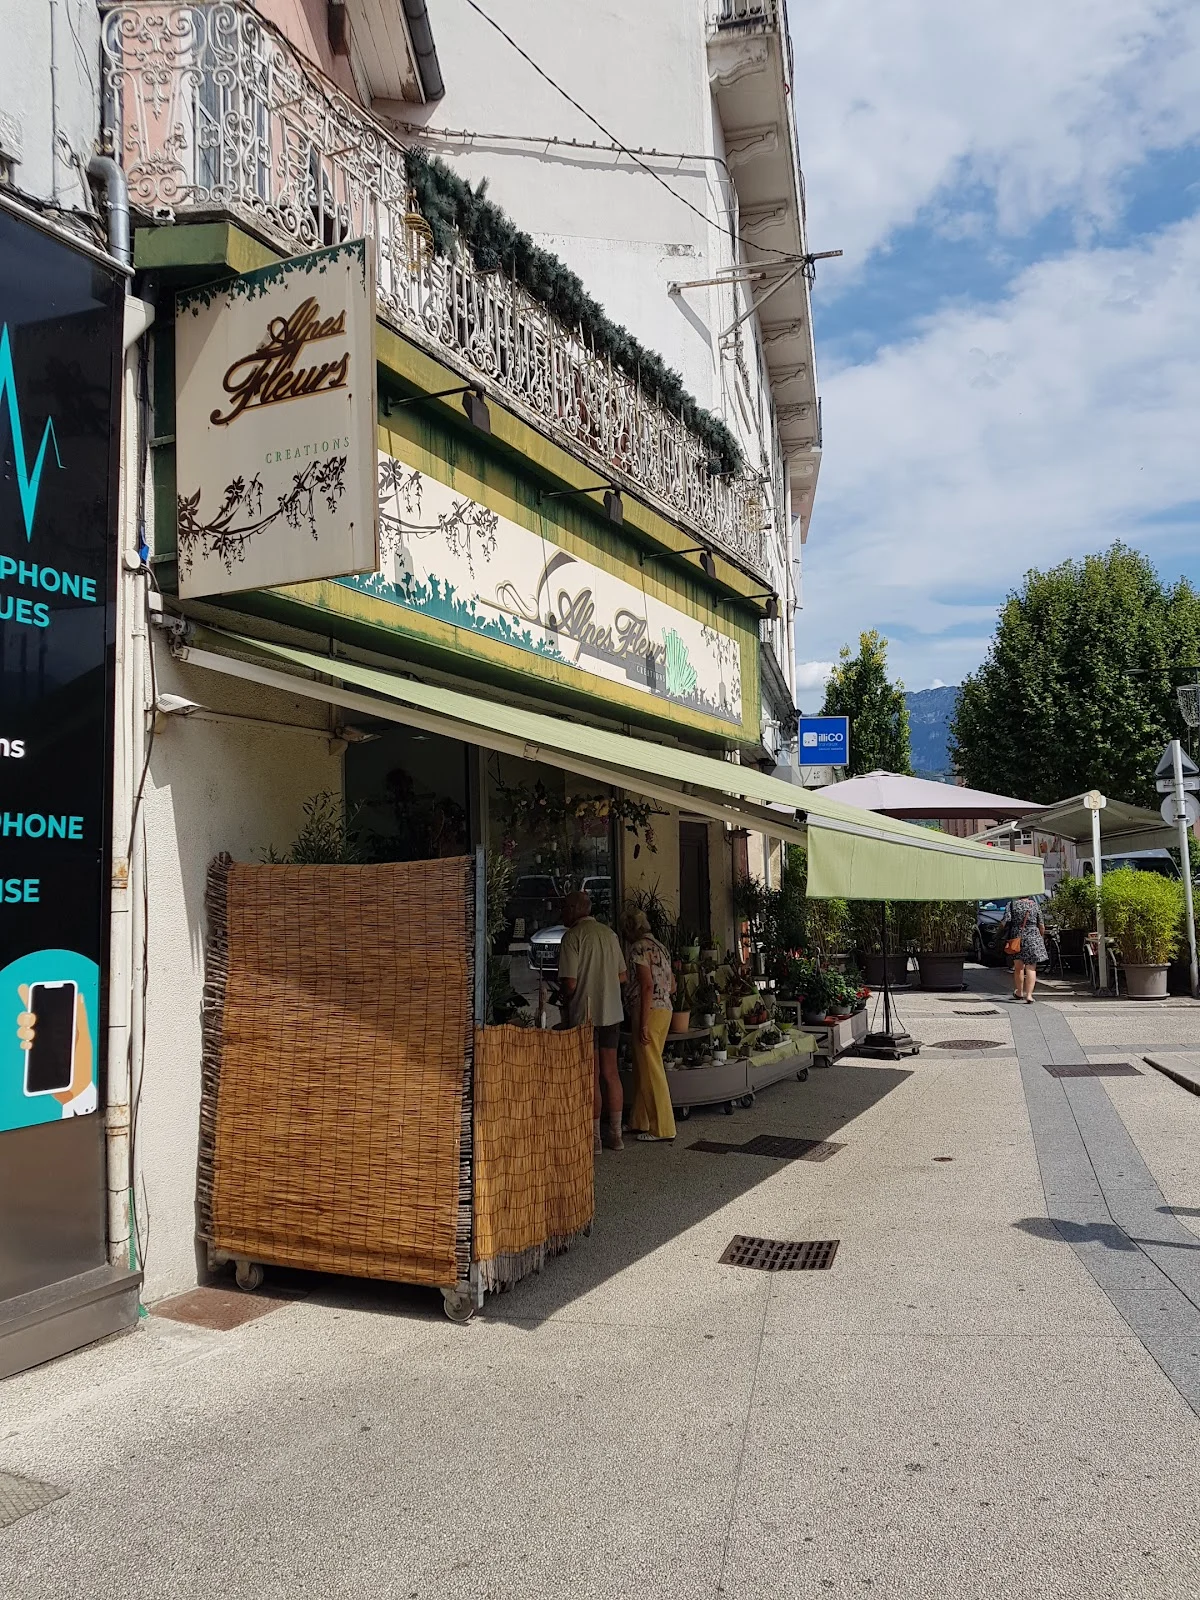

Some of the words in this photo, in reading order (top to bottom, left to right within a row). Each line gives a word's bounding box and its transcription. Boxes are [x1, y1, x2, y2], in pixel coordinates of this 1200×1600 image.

[256, 296, 346, 362] Alpes
[210, 351, 350, 425] Fleurs
[265, 436, 350, 464] CREATIONS
[548, 586, 615, 661] Alpes
[613, 606, 667, 667] Fleurs
[0, 811, 84, 840] HONE
